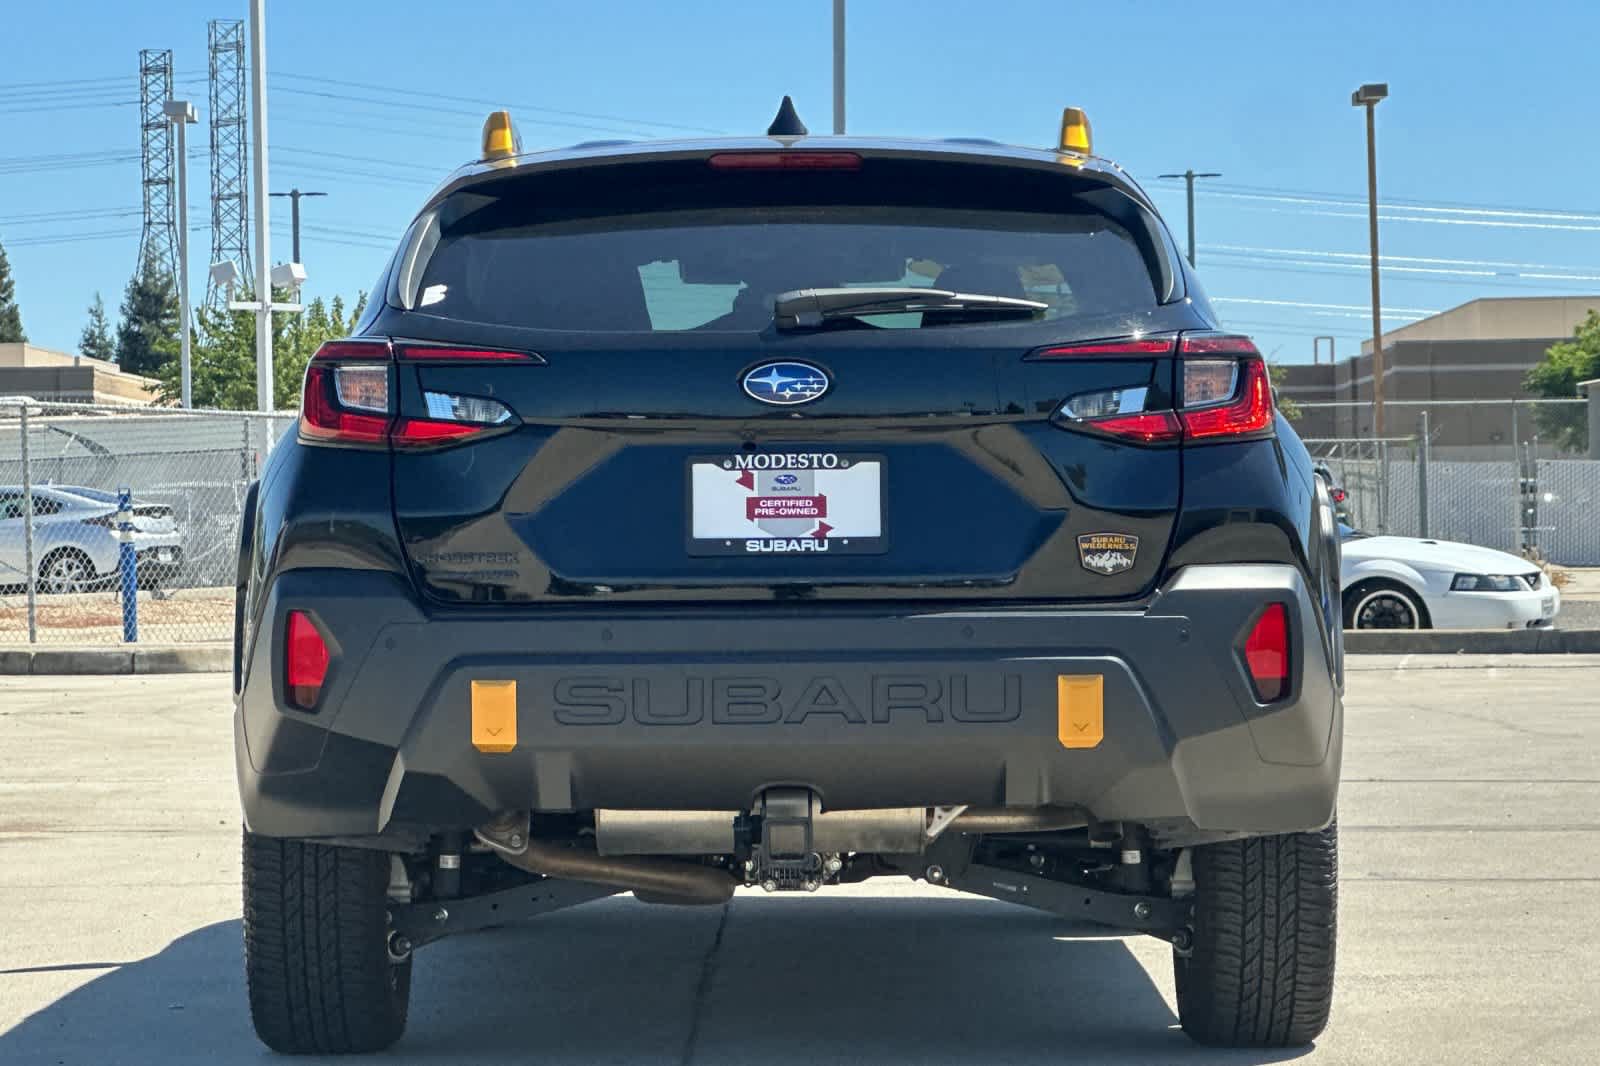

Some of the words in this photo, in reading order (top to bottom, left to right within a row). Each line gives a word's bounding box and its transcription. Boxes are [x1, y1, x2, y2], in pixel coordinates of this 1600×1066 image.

[734, 453, 838, 469] MODESTO
[759, 499, 813, 507] CERTIFIED
[754, 507, 818, 516] PRE-OWNED
[745, 539, 829, 552] SUBARU
[553, 674, 1022, 727] SUBARU
